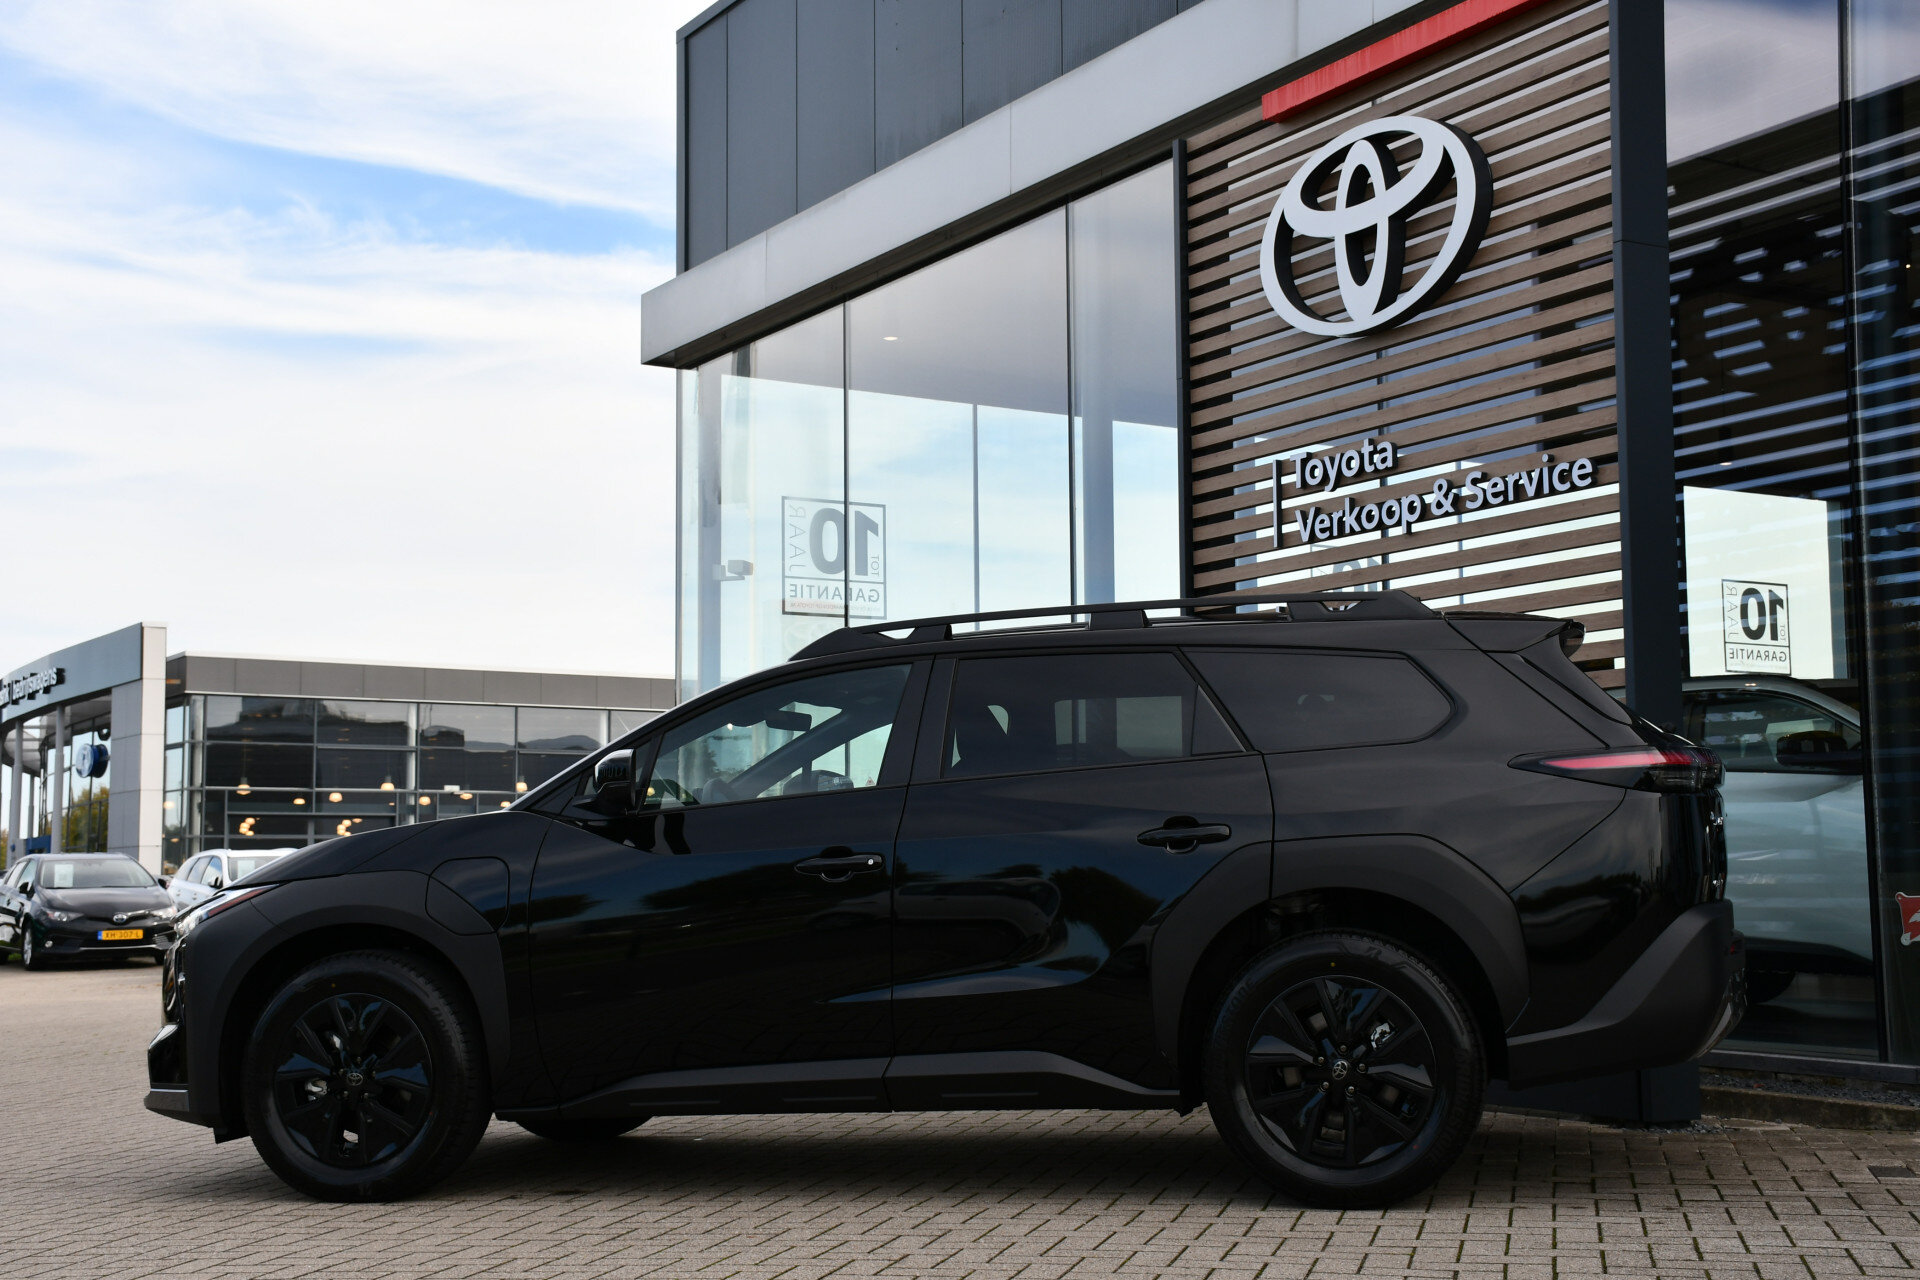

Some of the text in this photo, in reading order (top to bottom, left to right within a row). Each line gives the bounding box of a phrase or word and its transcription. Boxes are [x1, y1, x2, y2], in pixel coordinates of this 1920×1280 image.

[1289, 437, 1396, 492] Toyota
[1294, 453, 1595, 543] Verkoop & Service
